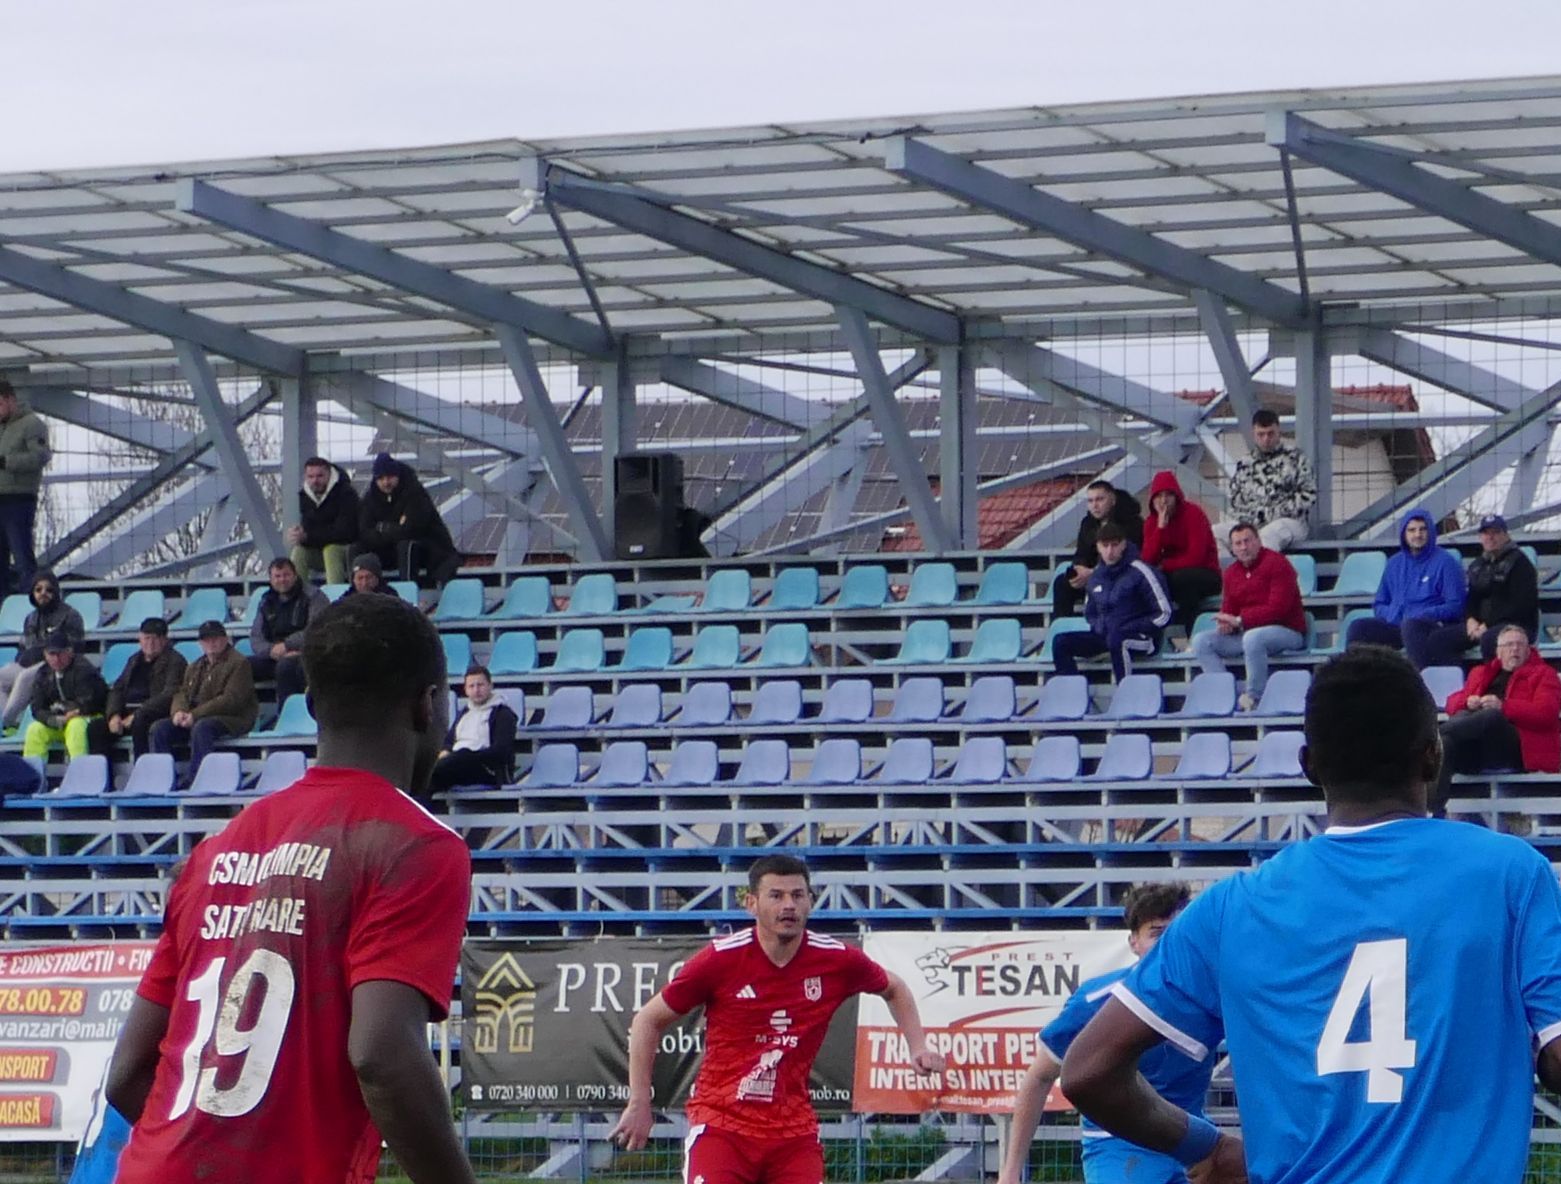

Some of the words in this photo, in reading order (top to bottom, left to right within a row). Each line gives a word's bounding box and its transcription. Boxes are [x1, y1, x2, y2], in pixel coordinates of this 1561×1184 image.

[208, 851, 259, 886] CSM
[10, 950, 114, 975] CONSTRUCTII
[991, 952, 1074, 962] PREST
[554, 961, 685, 1013] PRE
[951, 964, 1080, 996] TESAN
[169, 949, 295, 1120] 19
[1317, 938, 1417, 1103] 4
[868, 1032, 998, 1065] TRASPORT
[1006, 1032, 1039, 1065] PE
[489, 1084, 515, 1100] 0720
[516, 1084, 536, 1100] 340
[537, 1084, 558, 1100] 000
[576, 1084, 605, 1100] 0790
[608, 1084, 631, 1100] 340
[946, 1068, 967, 1090] SI
[0, 1096, 41, 1123] ACASĂ
